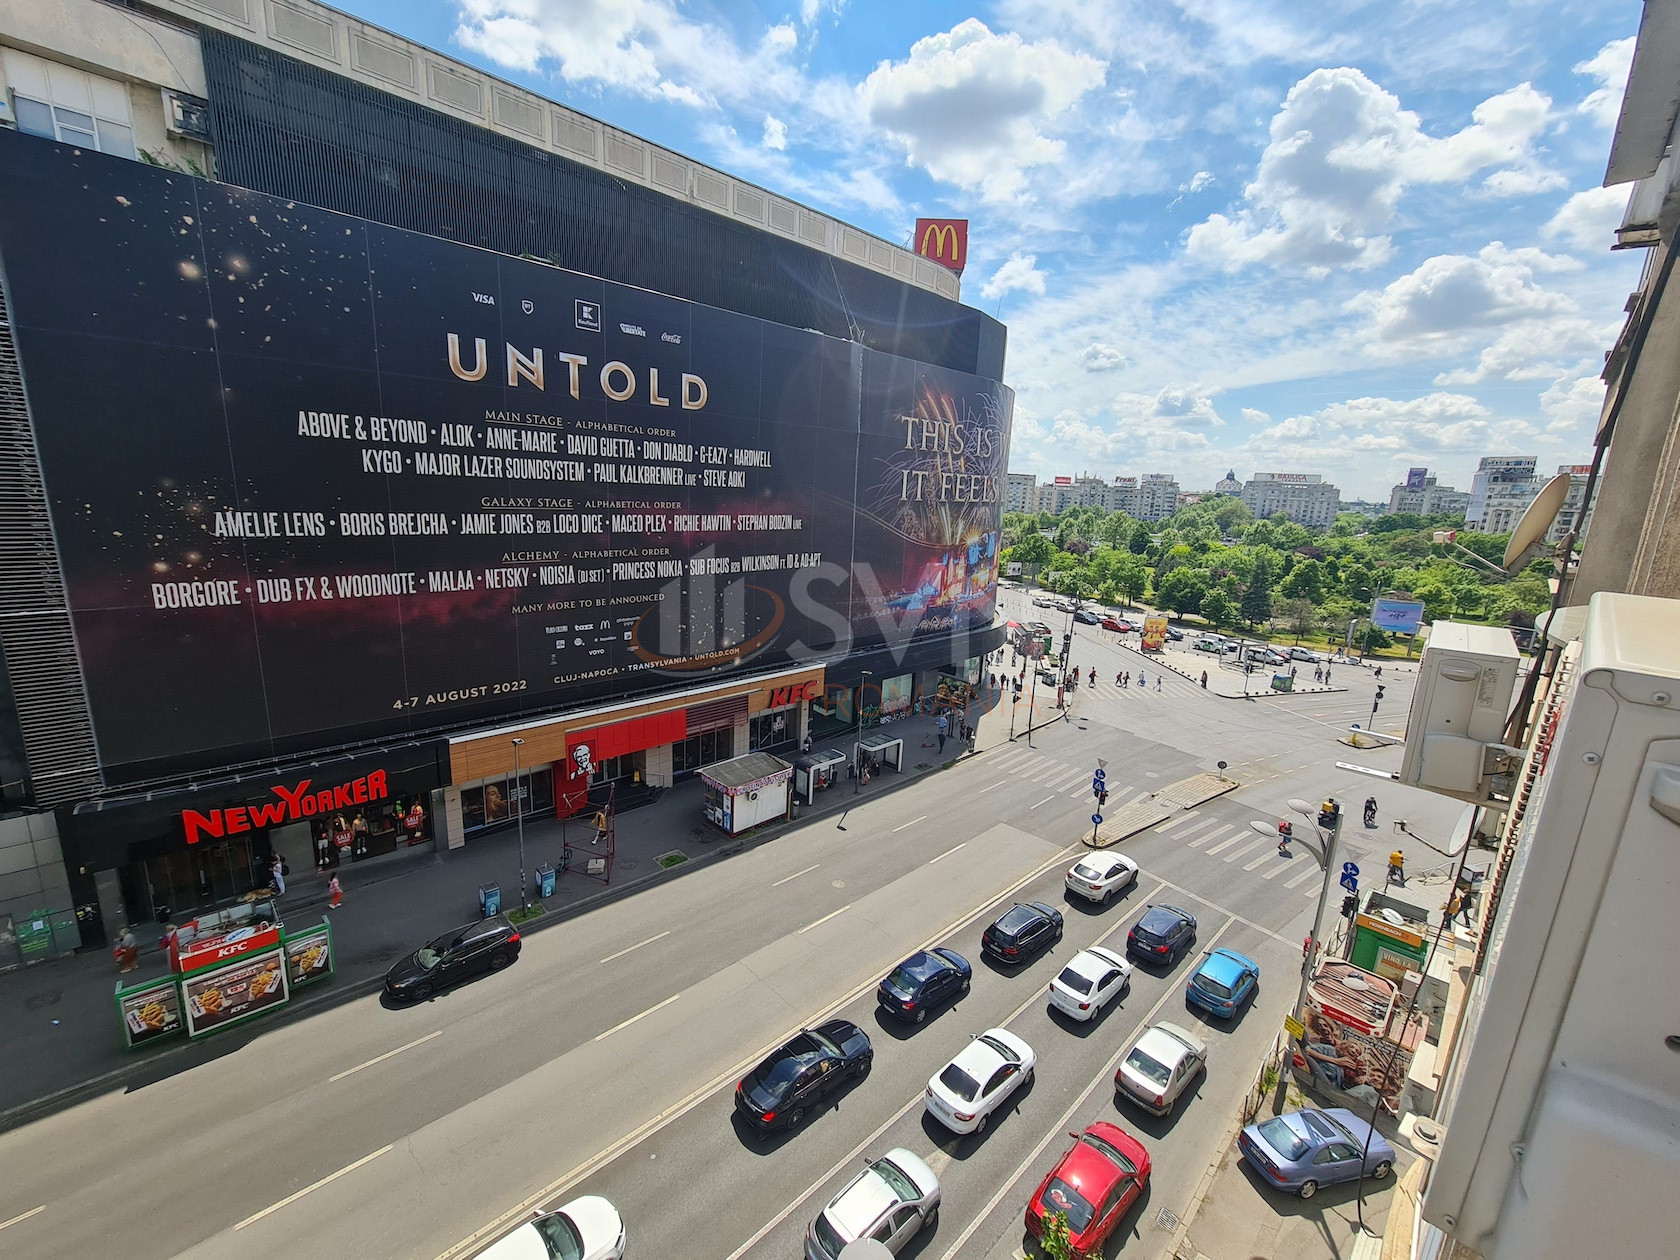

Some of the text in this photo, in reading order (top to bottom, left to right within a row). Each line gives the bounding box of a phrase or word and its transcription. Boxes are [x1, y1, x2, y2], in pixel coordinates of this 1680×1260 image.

[471, 292, 495, 306] VISA
[447, 332, 708, 411] UNTOLD
[485, 410, 676, 438] MAIN STAGE ALPHABETICAL ORDER
[901, 416, 964, 454] THIS
[975, 427, 992, 458] IS
[298, 410, 772, 468] ABOVE & BEYOND ALOK ANNE-MARIE DAVID GUETTA DON DIABLO G-EAZY HARDWELL
[362, 449, 746, 488] KYGO MAJOR LAZER SOUNDSYSTEM PAUL KALKBRENNER LIVE STEVE AOKI
[901, 470, 999, 502] IT FEELS
[481, 497, 682, 510] GALAXY STAGE ALPHABETICAL ORDER
[283, 512, 326, 536] LENS
[340, 512, 385, 536] BORIS
[388, 513, 448, 536] BREJCHA
[460, 514, 496, 534] JAMIE
[500, 514, 534, 534] JONES
[536, 520, 550, 534] B2B
[553, 514, 578, 534] LOCO
[581, 514, 603, 534] DICE
[612, 514, 643, 533] MACEO
[644, 514, 667, 533] PLEX
[674, 514, 700, 532] RICHIE
[702, 514, 732, 532] HAWTIN
[738, 514, 768, 531] STEPHAN
[769, 514, 792, 530] BODZIN
[502, 548, 670, 561] ALCHEMY ALPHABETICAL ORDER
[256, 578, 292, 604] DUB
[295, 576, 315, 602] FX
[320, 576, 334, 599] &
[335, 572, 416, 598] WOODNOTE
[428, 570, 475, 592] MALAA
[484, 568, 530, 590] NETSKY
[540, 565, 576, 586] NOISIA
[612, 560, 655, 581] PRINCESS
[657, 559, 683, 578] NOKIA
[690, 558, 705, 576] SUB
[706, 558, 730, 575] FOCUS
[730, 562, 740, 573] B2B
[742, 554, 779, 572] WILKINSON
[786, 554, 794, 568] ID
[794, 554, 799, 568] &
[512, 593, 665, 614] MANY MORE TO BE ANNOUNCED
[588, 648, 605, 656] VOYO
[554, 648, 740, 684] CLUJ-NAPOCA TRANSYLVANIA UNTOLD.COM
[392, 680, 528, 710] 4-7 AUGUST 2022
[770, 680, 820, 709] KFC
[336, 832, 351, 842] SALE
[218, 942, 248, 958] KFC
[1383, 952, 1400, 965] VINO
[230, 1002, 249, 1014] KFC
